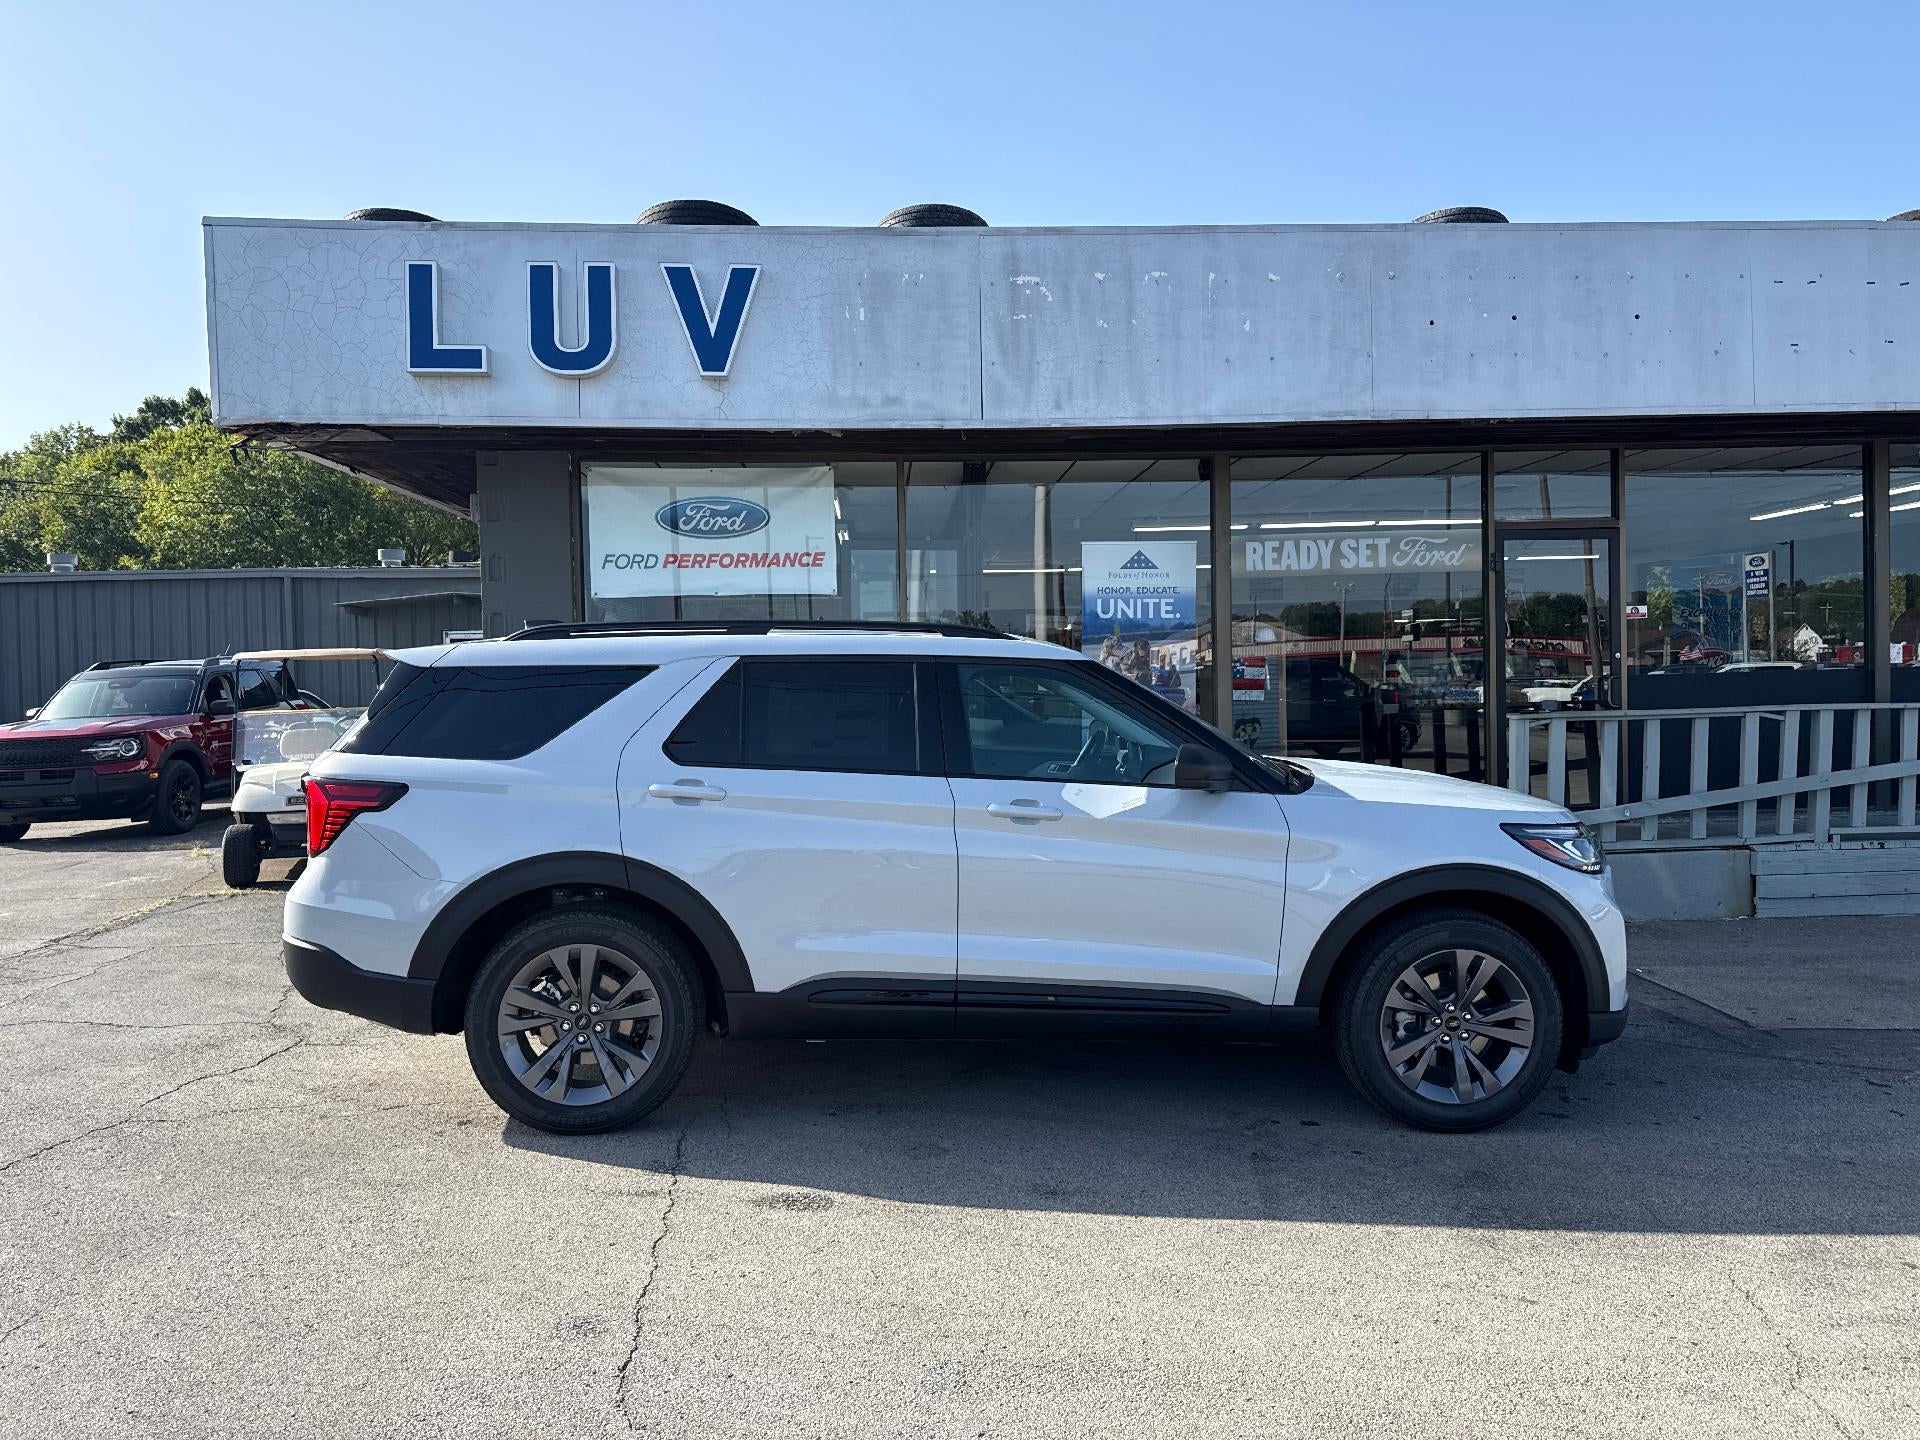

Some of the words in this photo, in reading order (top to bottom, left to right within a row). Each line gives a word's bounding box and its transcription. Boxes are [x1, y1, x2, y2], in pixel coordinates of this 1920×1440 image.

[405, 260, 762, 379] LUV
[678, 503, 748, 531] Ford
[602, 553, 659, 570] FORD
[662, 551, 826, 569] PERFORMANCE
[1245, 539, 1335, 572] READY
[1339, 537, 1391, 569] SET
[1391, 536, 1465, 567] Ford
[1141, 571, 1170, 579] HONOR
[1097, 587, 1134, 595] HONOR.
[1136, 586, 1181, 595] EDUCATE.
[1096, 598, 1181, 619] UNITE.
